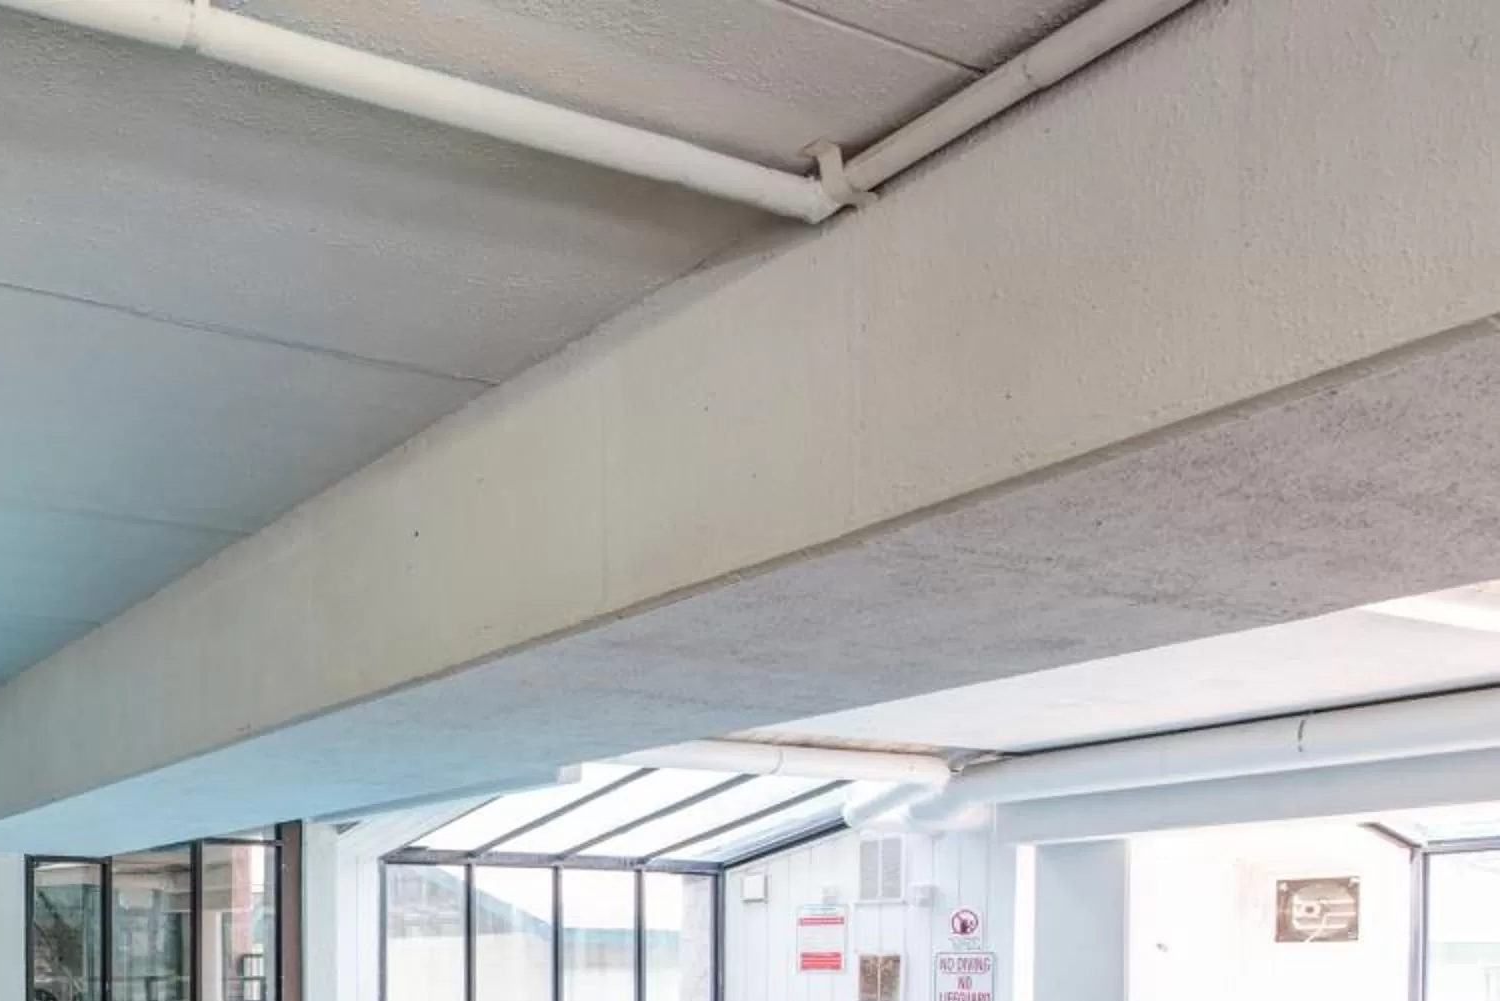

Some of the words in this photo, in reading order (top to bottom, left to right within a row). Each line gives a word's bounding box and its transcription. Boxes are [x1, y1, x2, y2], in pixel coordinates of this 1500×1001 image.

[940, 957, 954, 971] NO
[957, 957, 991, 972] DIVING
[957, 975, 972, 989] NO
